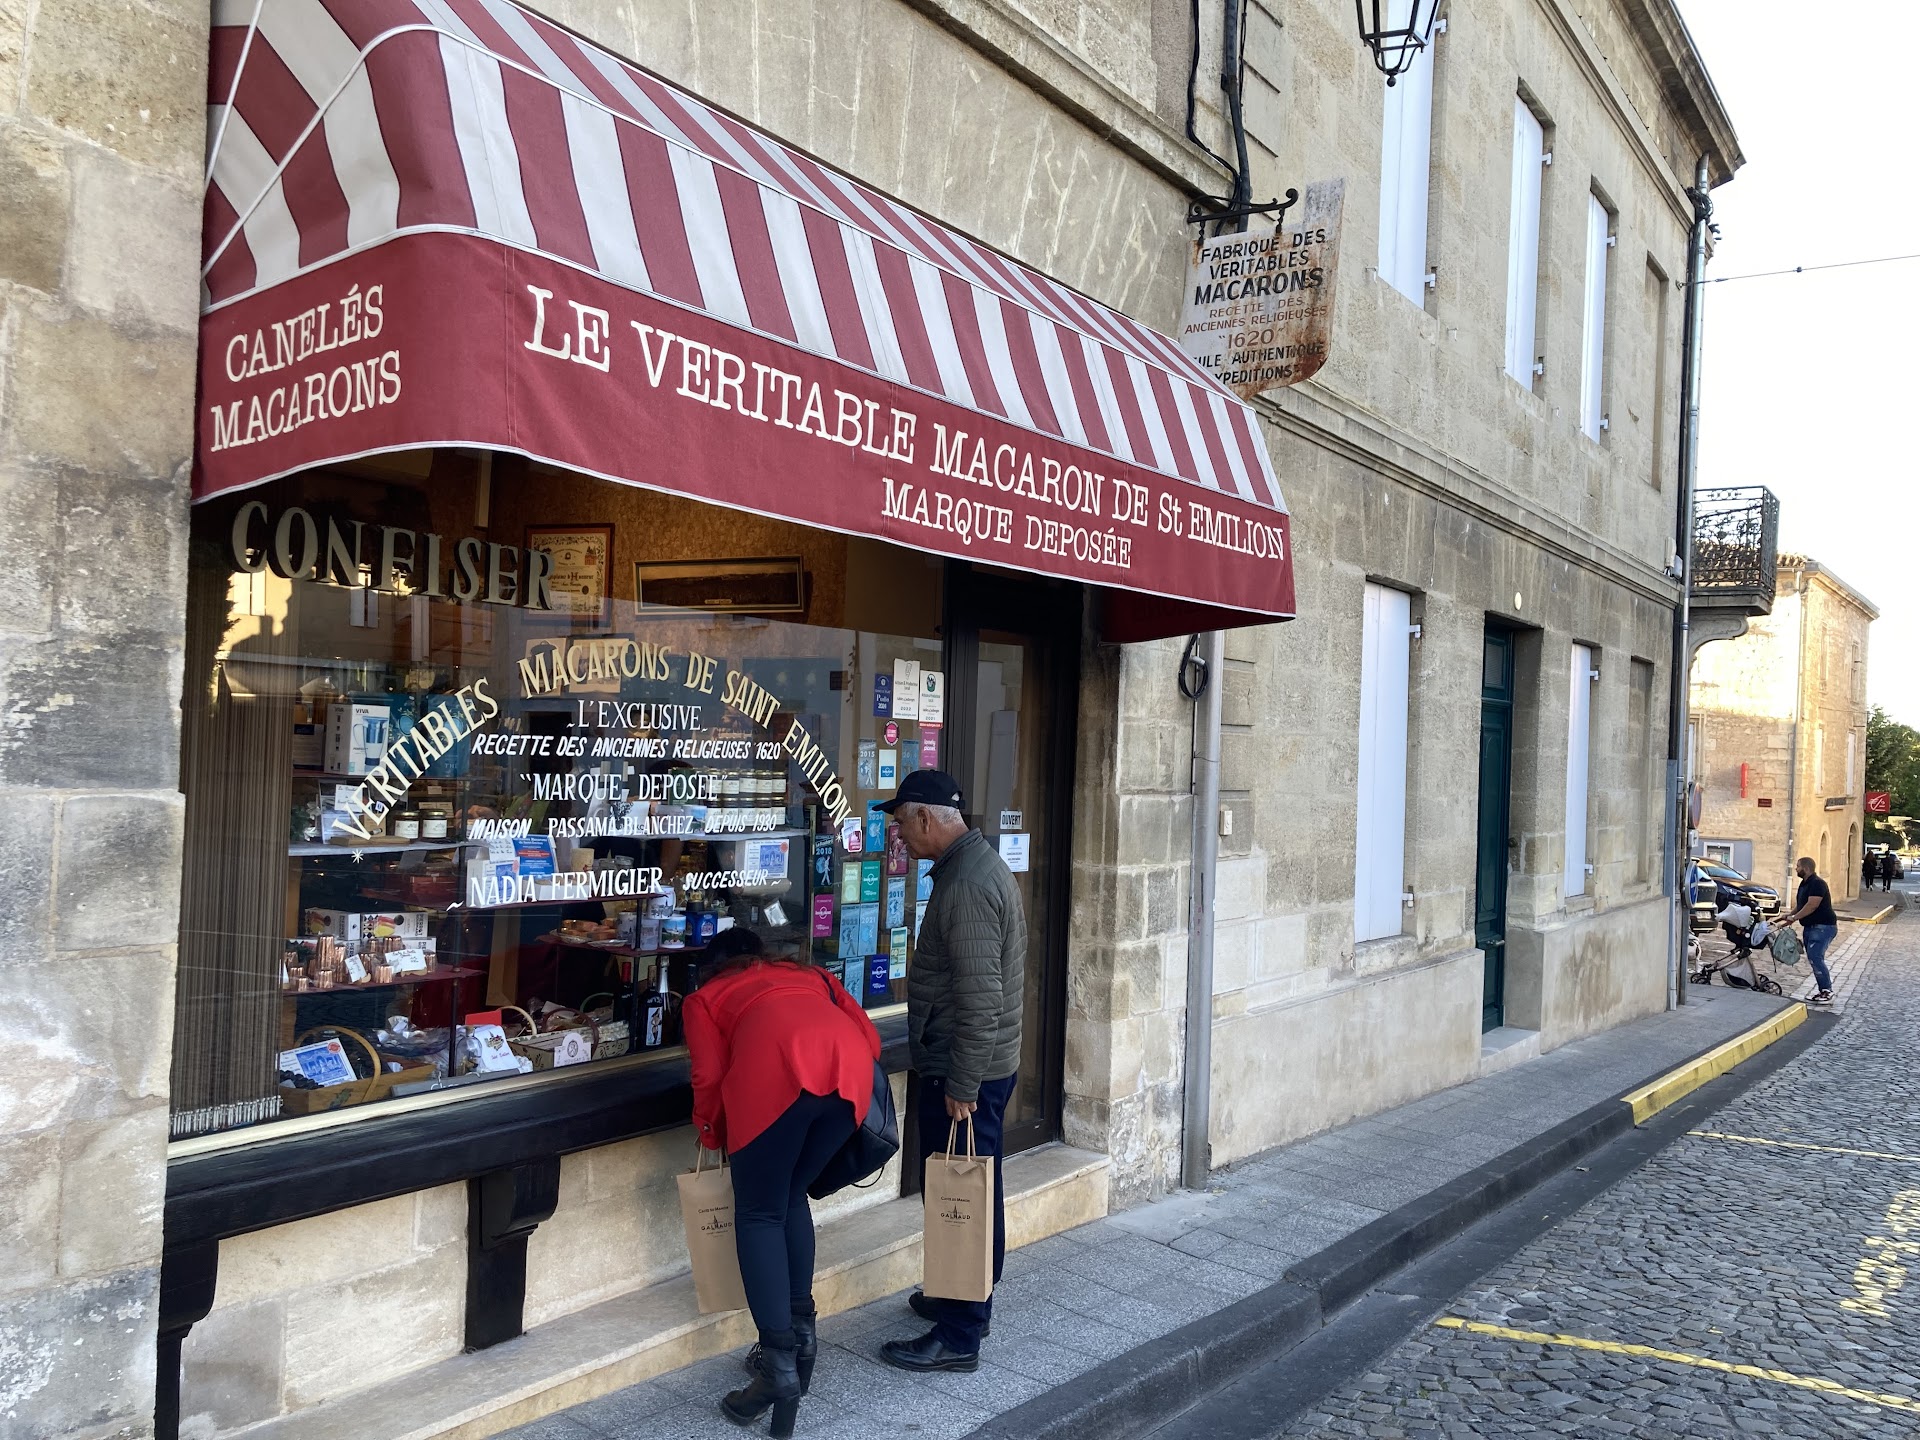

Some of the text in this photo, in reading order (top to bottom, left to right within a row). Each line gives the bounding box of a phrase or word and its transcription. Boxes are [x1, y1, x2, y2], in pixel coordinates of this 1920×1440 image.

[1201, 228, 1326, 264] FABRIQUE DES
[1210, 249, 1310, 280] VERITABLES
[1194, 266, 1324, 306] MACARONS
[1184, 304, 1328, 335] ANCIENNES RELIGIEUSES
[1209, 296, 1305, 318] RECETTE DES
[225, 283, 384, 383] CANELÉS
[1193, 341, 1326, 368] ULE AUTHENTIQUE
[1214, 364, 1293, 385] XPEDITIONS
[210, 350, 402, 454] MACARONS
[524, 284, 1286, 561] LE VERITABLE MACARON DE St EMILION
[881, 477, 1133, 569] MARQUE DEPOSÉE
[578, 700, 702, 731] L'EXCLUSIVE
[332, 640, 853, 841] VERITABLES MACARONS DE SAINT EMILION
[471, 733, 554, 756] RECETTE
[555, 736, 587, 757] DES
[591, 736, 669, 758] ANCIENNES
[672, 739, 752, 759] RELIGIEUSES
[468, 818, 533, 840] MAISON
[704, 813, 748, 834] DEPUIS
[751, 814, 777, 833] 1930
[1002, 814, 1022, 826] OUVERT
[470, 875, 537, 908] NADIA
[550, 866, 665, 901] FERMIGIER
[682, 869, 769, 892] SUCCESSEUR
